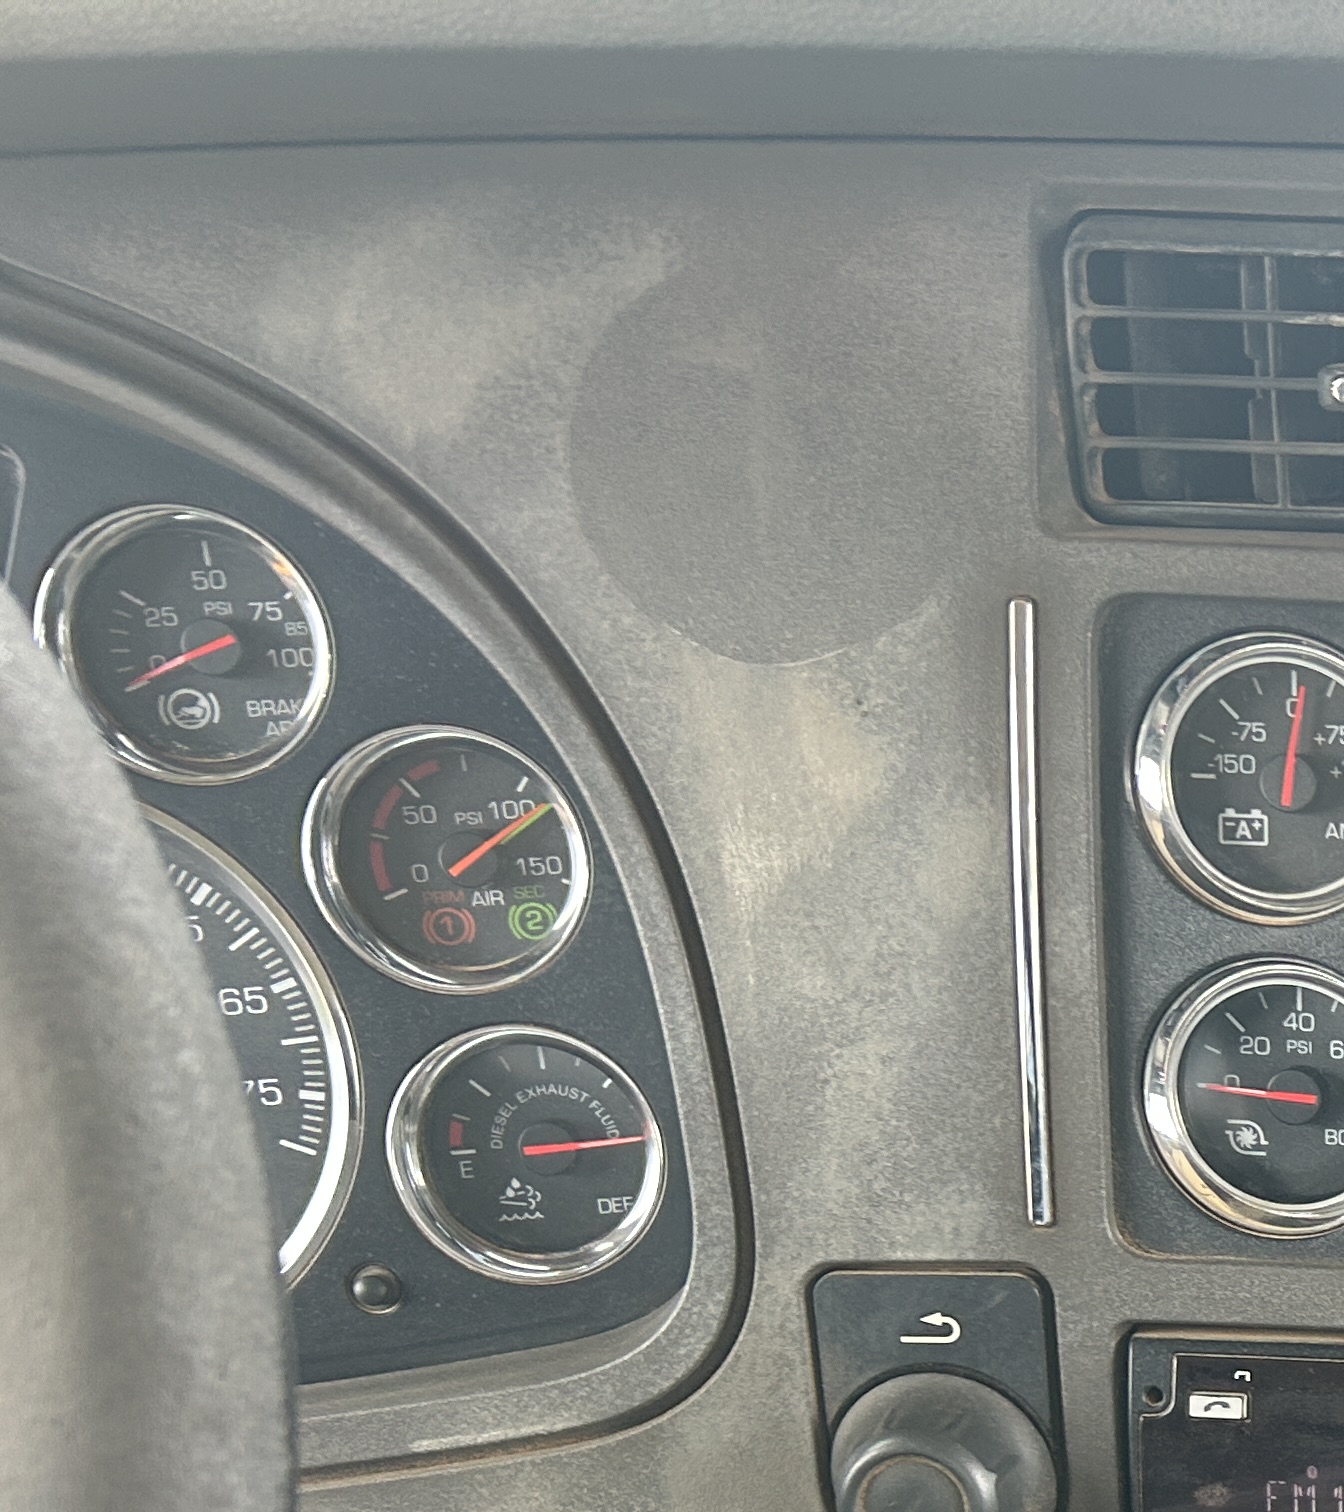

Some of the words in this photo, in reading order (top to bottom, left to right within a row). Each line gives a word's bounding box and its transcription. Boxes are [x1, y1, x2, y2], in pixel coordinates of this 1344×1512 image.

[191, 569, 227, 590] 50
[143, 607, 178, 627] 25
[203, 602, 232, 616] PSI
[248, 601, 282, 622] 75
[266, 648, 315, 668] 100
[1231, 721, 1267, 743] -75
[1207, 753, 1256, 775] -150
[402, 805, 437, 825] 50
[454, 810, 483, 825] PSI
[488, 799, 536, 820] 100
[411, 863, 430, 883] 0
[515, 855, 563, 877] 150
[422, 890, 465, 904] PRIM
[471, 890, 506, 907] AIR
[513, 885, 546, 898] SEC
[439, 916, 455, 936] 1
[525, 916, 544, 931] 2
[218, 986, 268, 1016] 65
[1283, 1012, 1315, 1032] 40
[1239, 1036, 1270, 1056] 20
[1286, 1039, 1313, 1054] PSI
[490, 1102, 518, 1150] DIESEL
[516, 1083, 592, 1103] EXHAUST
[588, 1100, 620, 1139] FLUID
[459, 1160, 475, 1179] E
[597, 1195, 634, 1214] DEF
